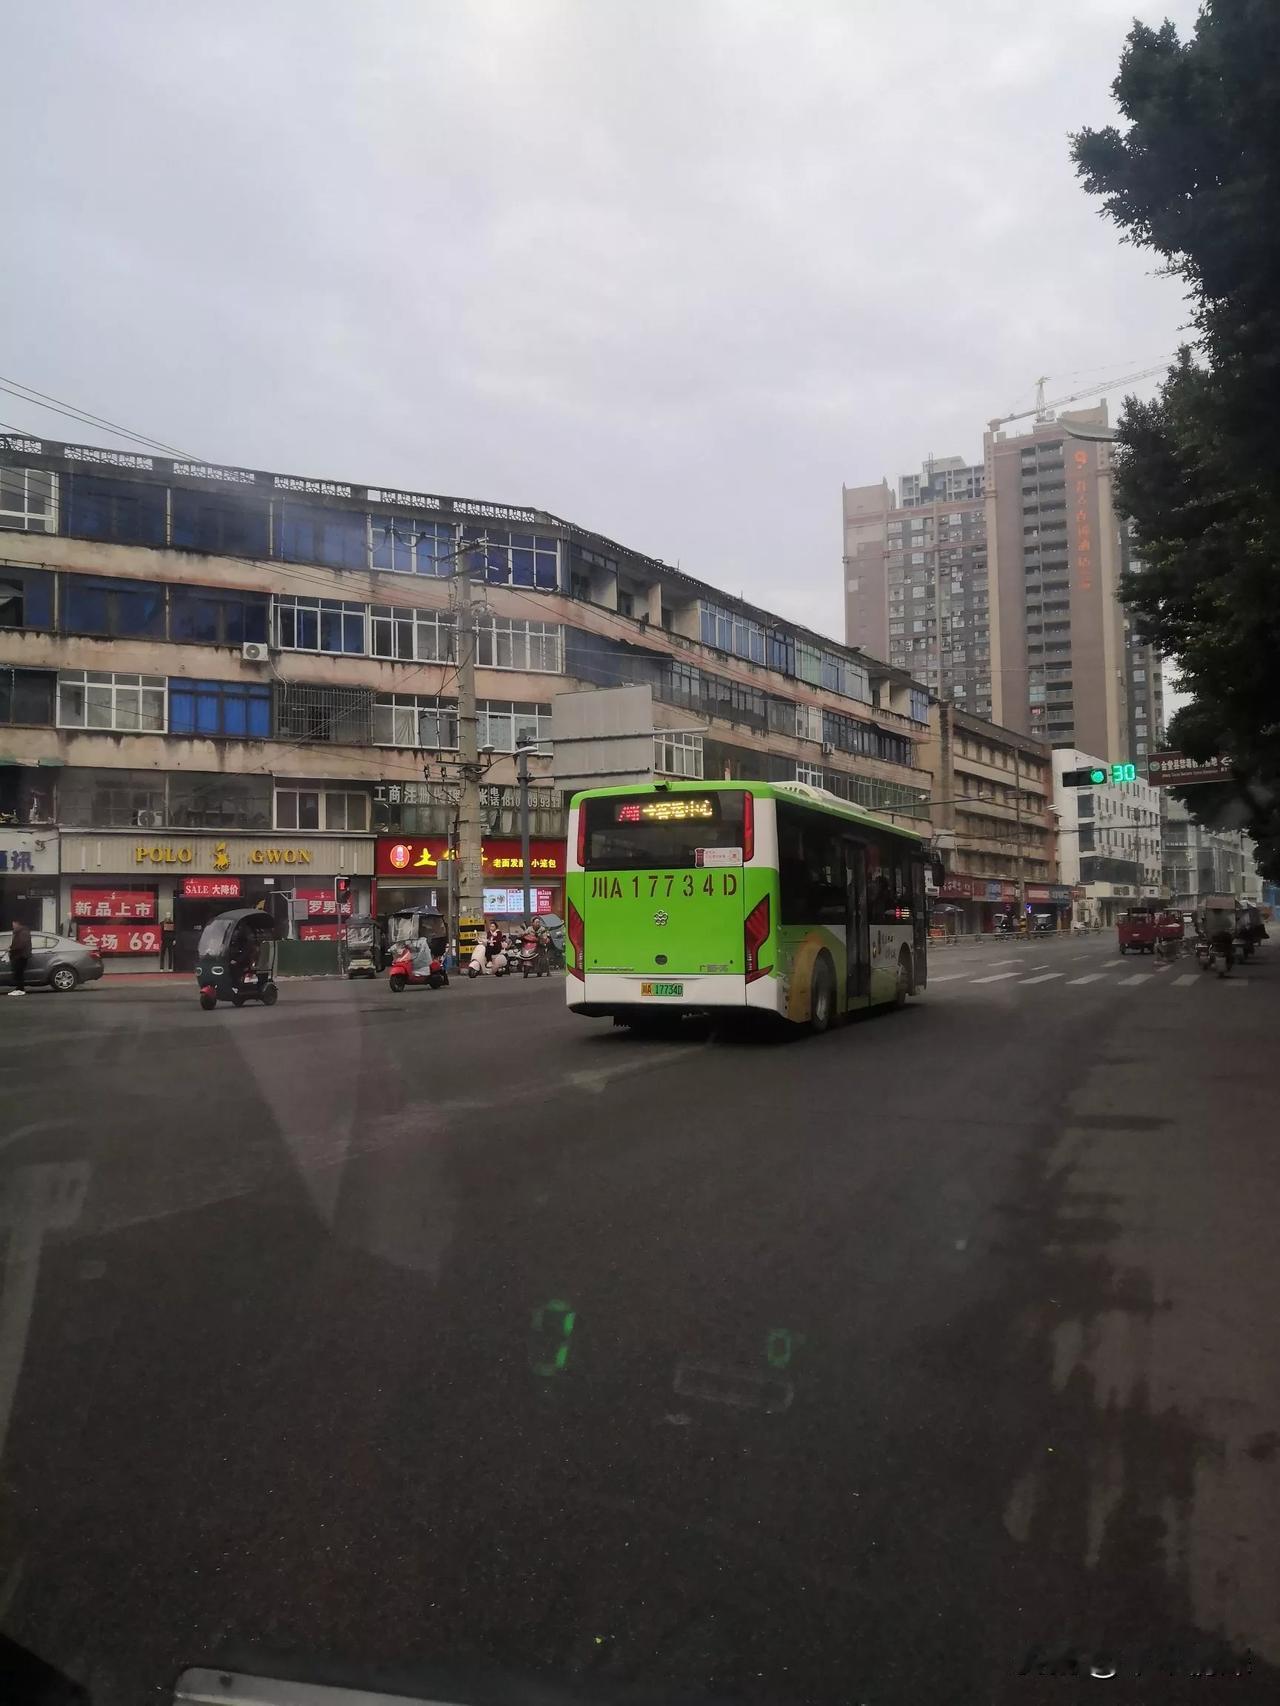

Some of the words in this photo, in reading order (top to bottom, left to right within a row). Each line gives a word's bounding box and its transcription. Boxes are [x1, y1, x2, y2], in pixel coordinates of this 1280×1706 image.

[1113, 764, 1136, 781] 30
[135, 847, 193, 864] POLO
[251, 849, 313, 866] GWON
[185, 885, 209, 894] SALE
[212, 885, 239, 896] 大降价
[75, 901, 152, 917] 新品上市
[83, 934, 118, 950] 全场
